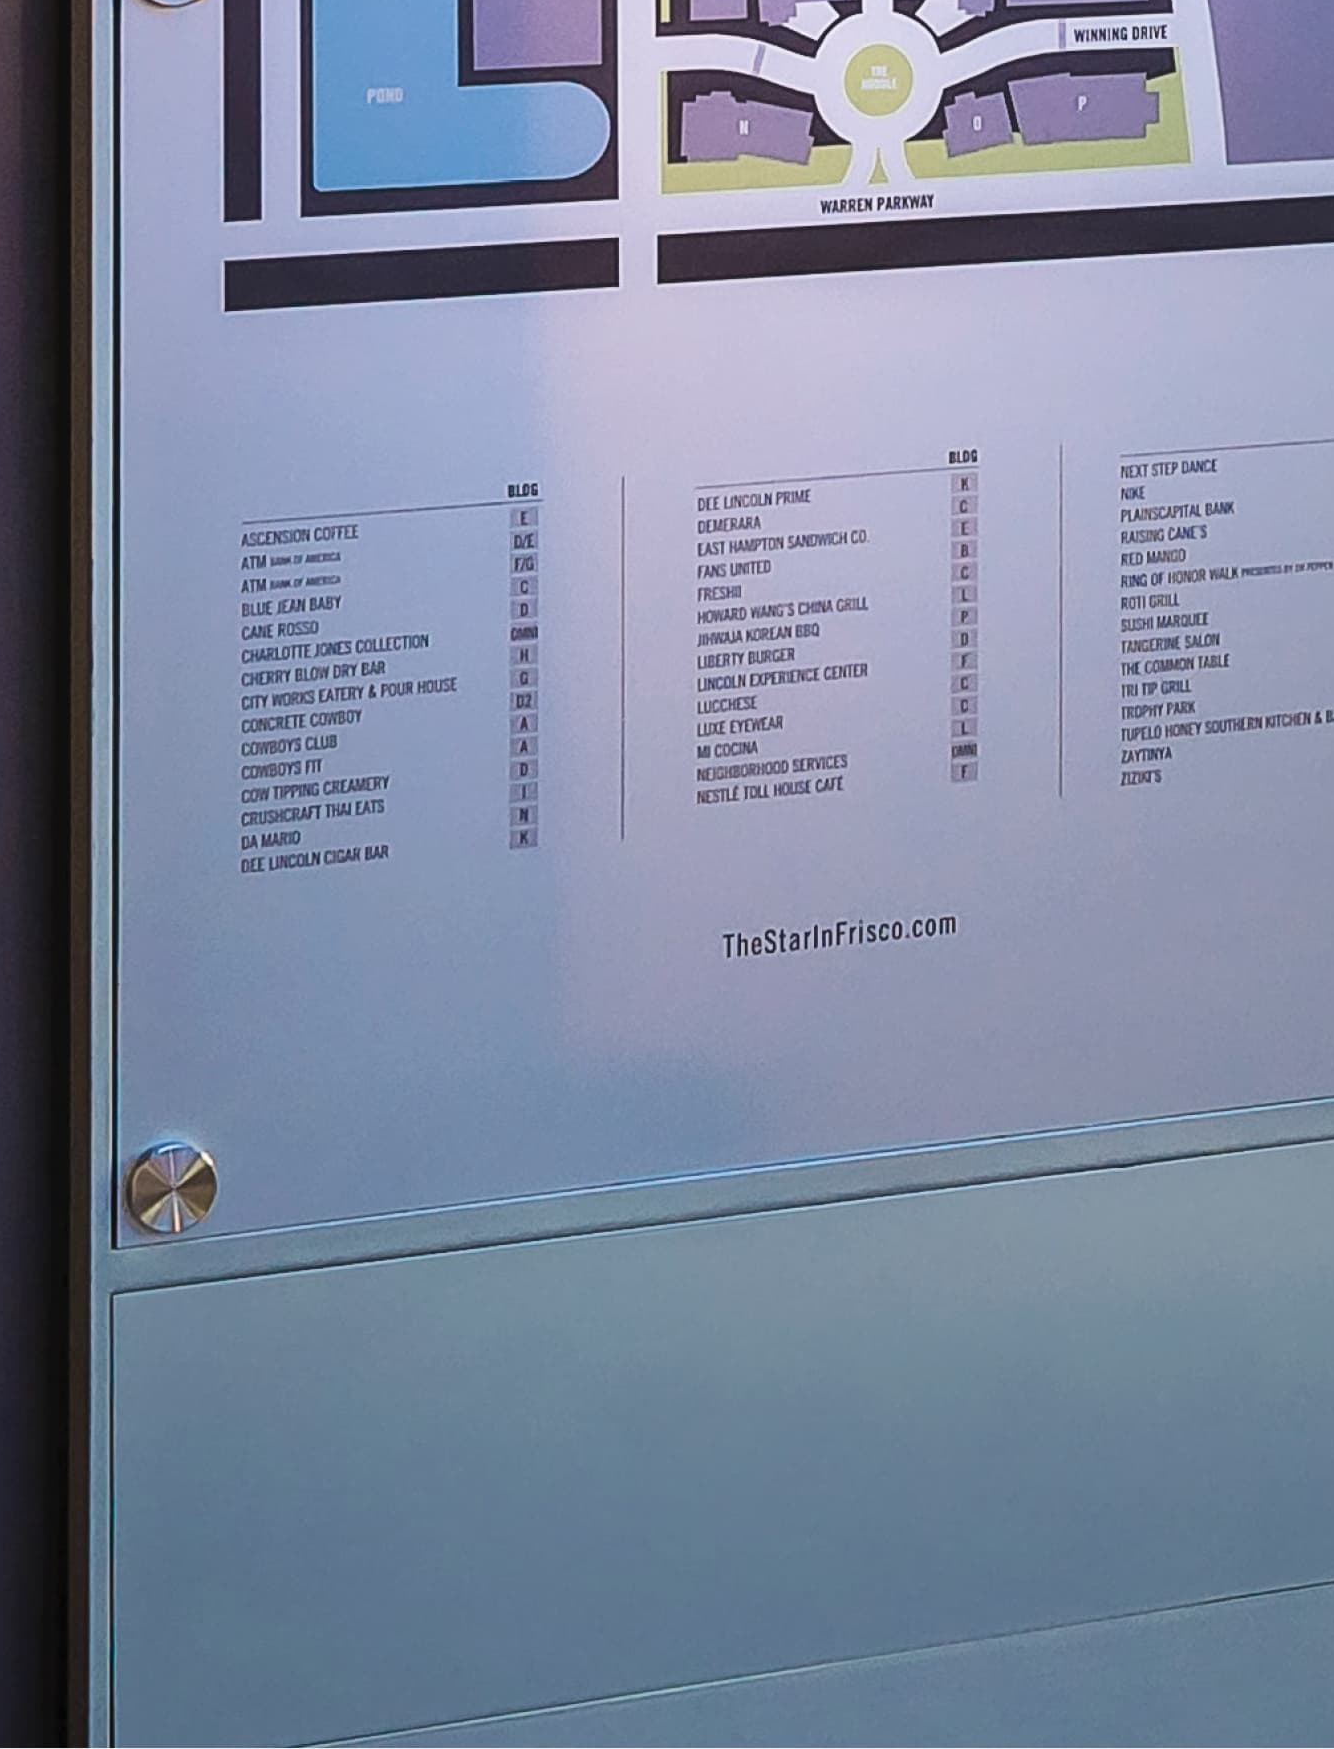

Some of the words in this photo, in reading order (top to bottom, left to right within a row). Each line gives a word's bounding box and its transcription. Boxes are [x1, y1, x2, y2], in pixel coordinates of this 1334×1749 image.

[1074, 28, 1127, 42] WINNING
[1132, 25, 1167, 39] DRIVE
[367, 88, 403, 104] POND
[1078, 96, 1087, 111] P
[820, 199, 872, 214] WARREN
[877, 195, 934, 210] PARKWAY
[949, 450, 977, 464] BLDG
[1121, 464, 1149, 479] NEXT
[1152, 462, 1178, 477] STEP
[1182, 459, 1217, 475] DANCE
[698, 497, 720, 511] DEE
[724, 494, 772, 509] LINCOLN
[776, 489, 811, 505] PRIME
[1121, 486, 1145, 500] NIKE
[698, 516, 761, 534] DEMERARA
[1121, 529, 1164, 544] RAISING
[1168, 525, 1208, 541] CANE'S
[241, 529, 310, 547] ASCENSION
[314, 524, 358, 541] COFFEE
[241, 555, 267, 570] ATM
[1121, 552, 1143, 566] RED
[1147, 548, 1186, 564] MANGO
[698, 564, 726, 579] FANS
[730, 560, 771, 576] UNITED
[242, 601, 273, 617] BLUE
[276, 598, 306, 615] JEAN
[309, 596, 341, 611] BABY
[241, 624, 273, 640] CANE
[278, 621, 319, 637] ROSSO
[1122, 636, 1181, 654] TANGERINE
[1185, 633, 1220, 649] SALON
[698, 654, 744, 669] LIBERTY
[748, 648, 795, 664] BURGER
[698, 674, 746, 692] LINCOLN
[750, 668, 819, 687] EXPERIENCE
[824, 663, 867, 680] CENTER
[242, 696, 268, 710] CITY
[272, 690, 315, 707] WORKS
[319, 687, 363, 703] EATERY
[368, 685, 376, 698] &
[381, 682, 413, 698] POUR
[418, 677, 457, 694] HOUSE
[1122, 704, 1163, 720] TROPHY
[1167, 701, 1195, 717] PARK
[242, 714, 306, 733] CONCRETE
[310, 710, 362, 727] COWBOY
[241, 738, 301, 756] COWBOYS
[306, 735, 337, 750] CLUB
[723, 915, 957, 959] TheStarInFrisco.com
